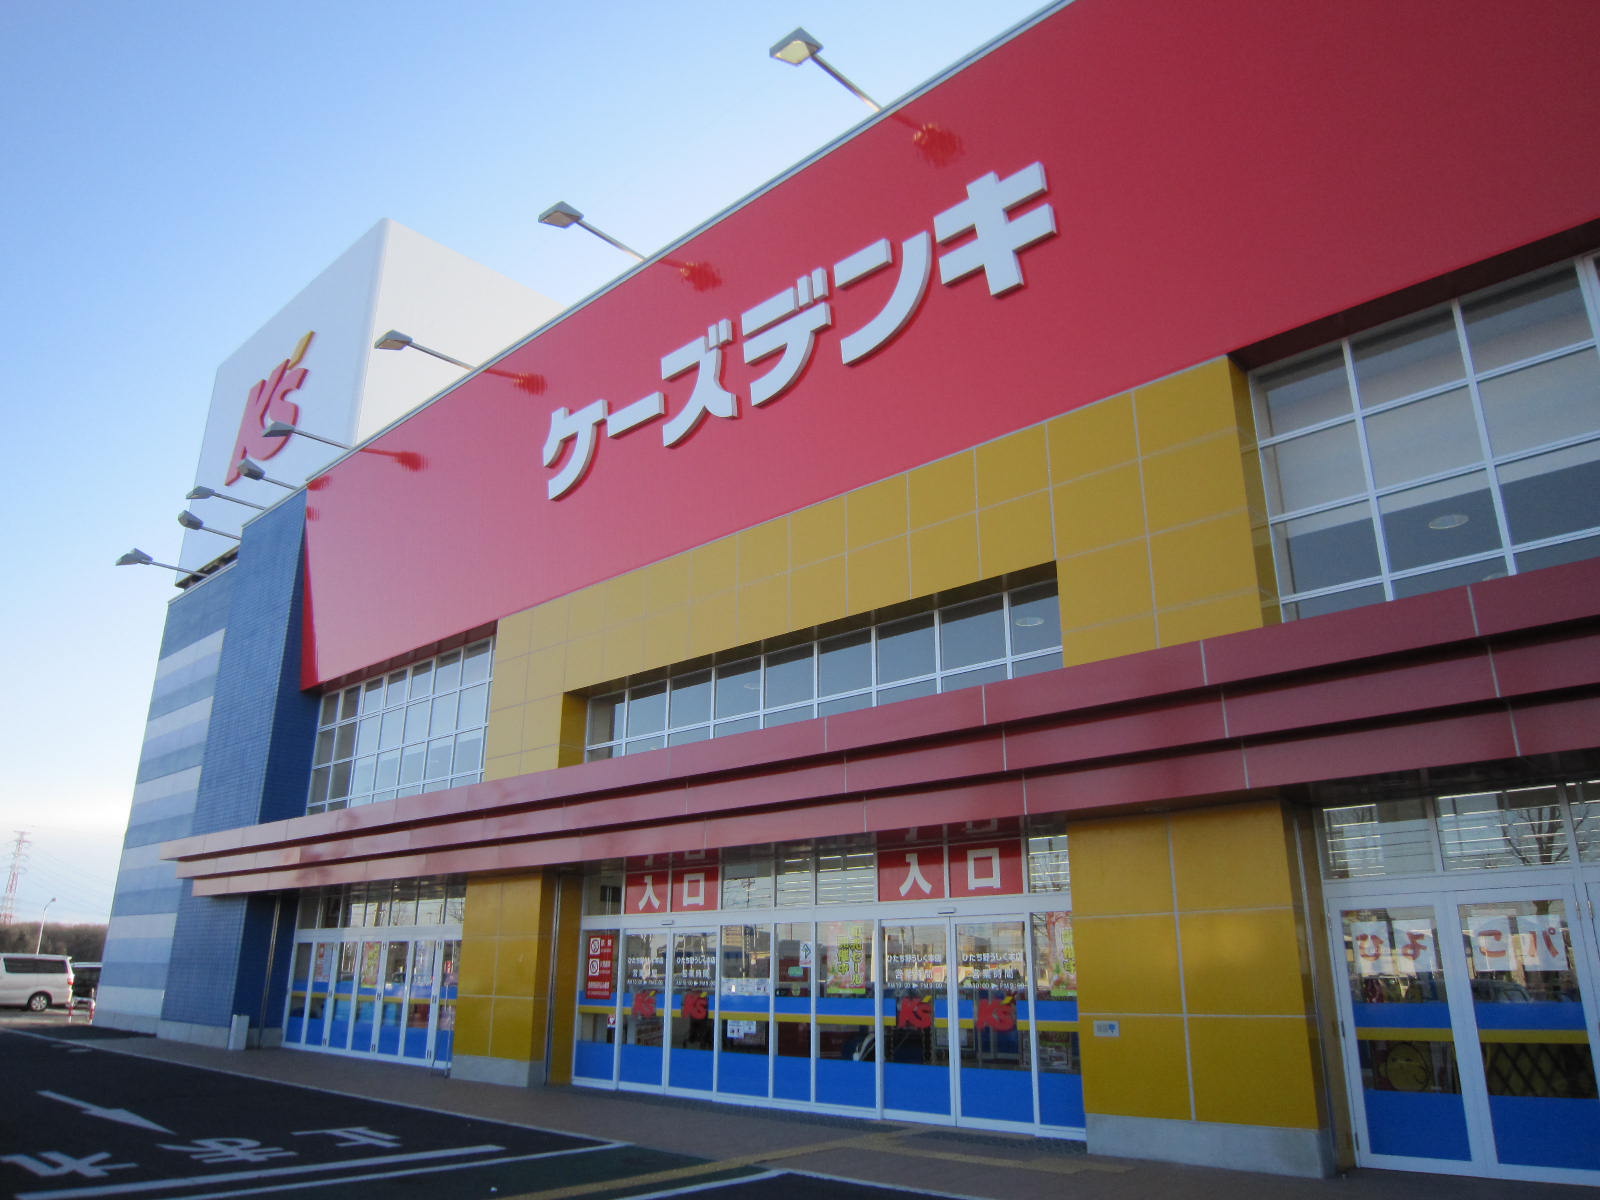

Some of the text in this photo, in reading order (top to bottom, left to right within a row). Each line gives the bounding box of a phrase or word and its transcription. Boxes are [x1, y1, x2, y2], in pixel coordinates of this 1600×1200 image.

[543, 161, 1057, 501] ケーズデンキ
[638, 872, 705, 911] 入口
[899, 847, 1001, 897] 入口
